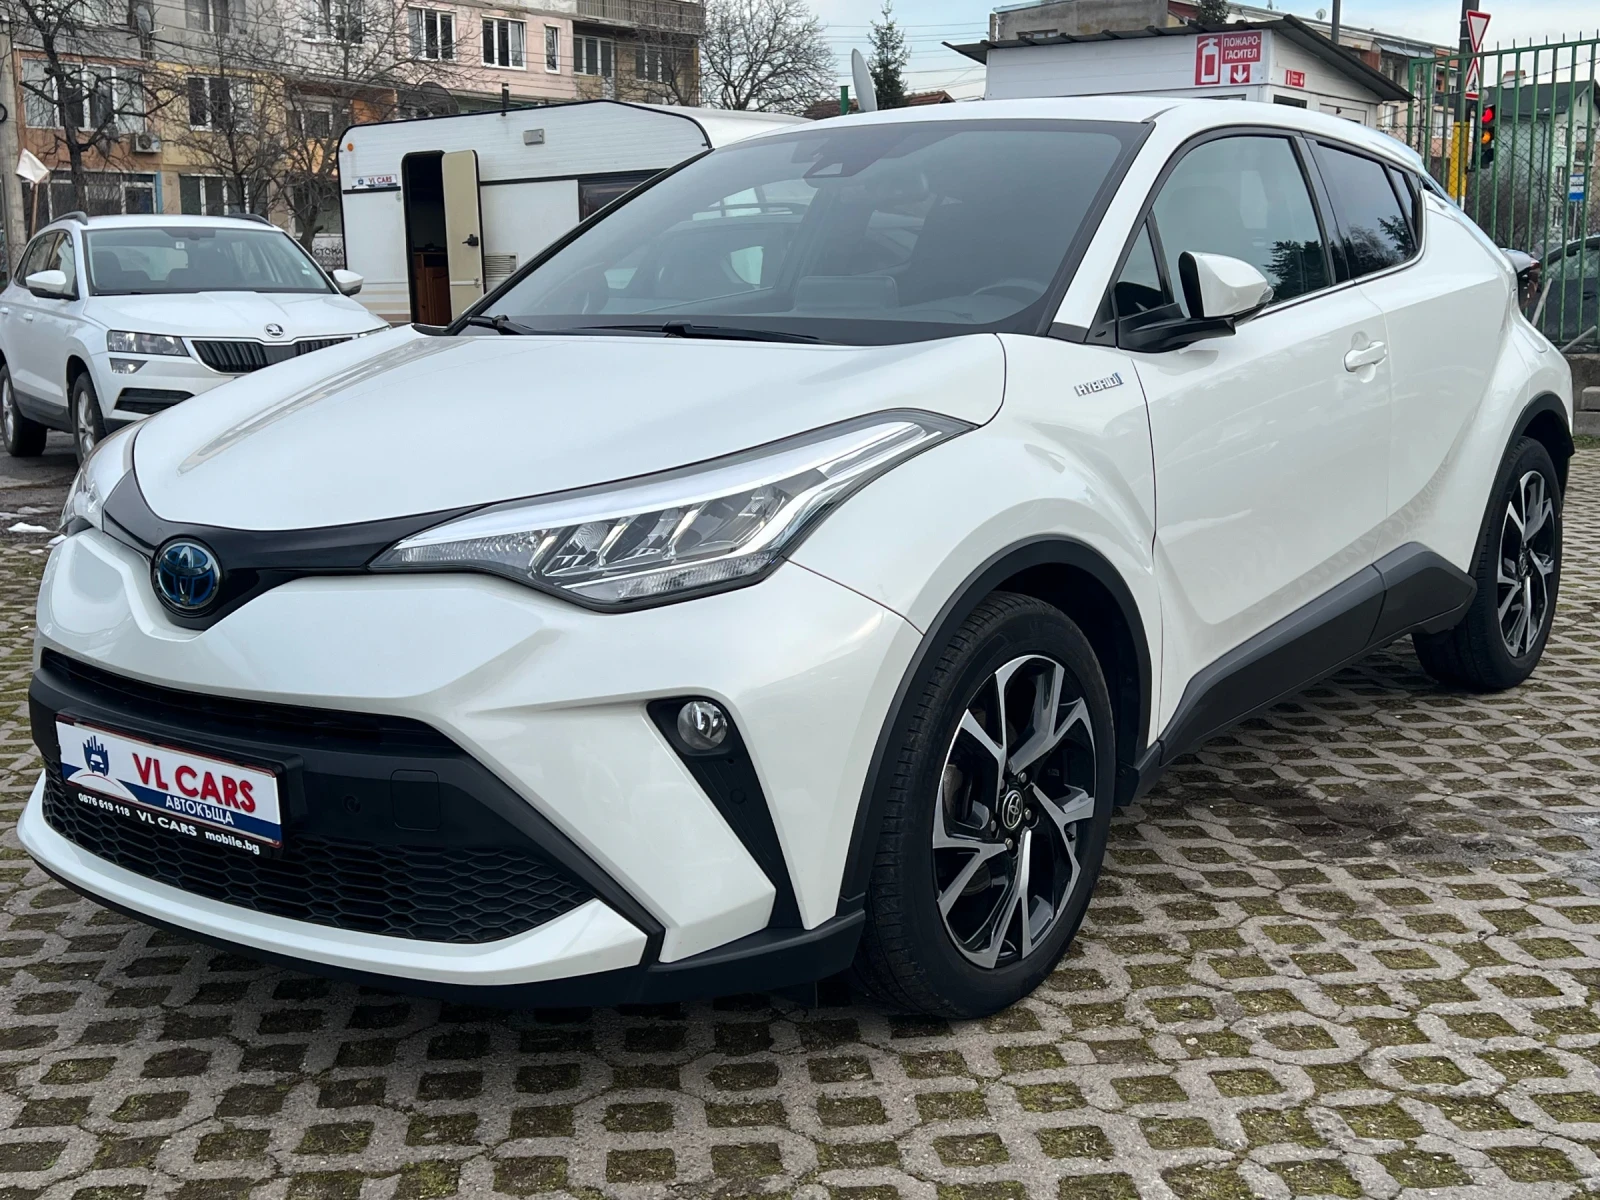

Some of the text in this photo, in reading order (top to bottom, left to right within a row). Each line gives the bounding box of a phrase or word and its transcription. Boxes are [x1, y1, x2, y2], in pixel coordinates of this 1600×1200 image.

[1223, 36, 1260, 47] ПОЖАРО-
[1225, 48, 1257, 60] ГАСИТЕЛ
[1073, 374, 1119, 397] HYBRID
[132, 752, 257, 813] VL CARS
[78, 792, 98, 807] 0876
[114, 805, 131, 817] 118
[136, 809, 156, 825] VL
[157, 817, 198, 837] CARS
[204, 830, 261, 856] mobile.bg
[165, 795, 235, 826] АВТОКЪЩА
